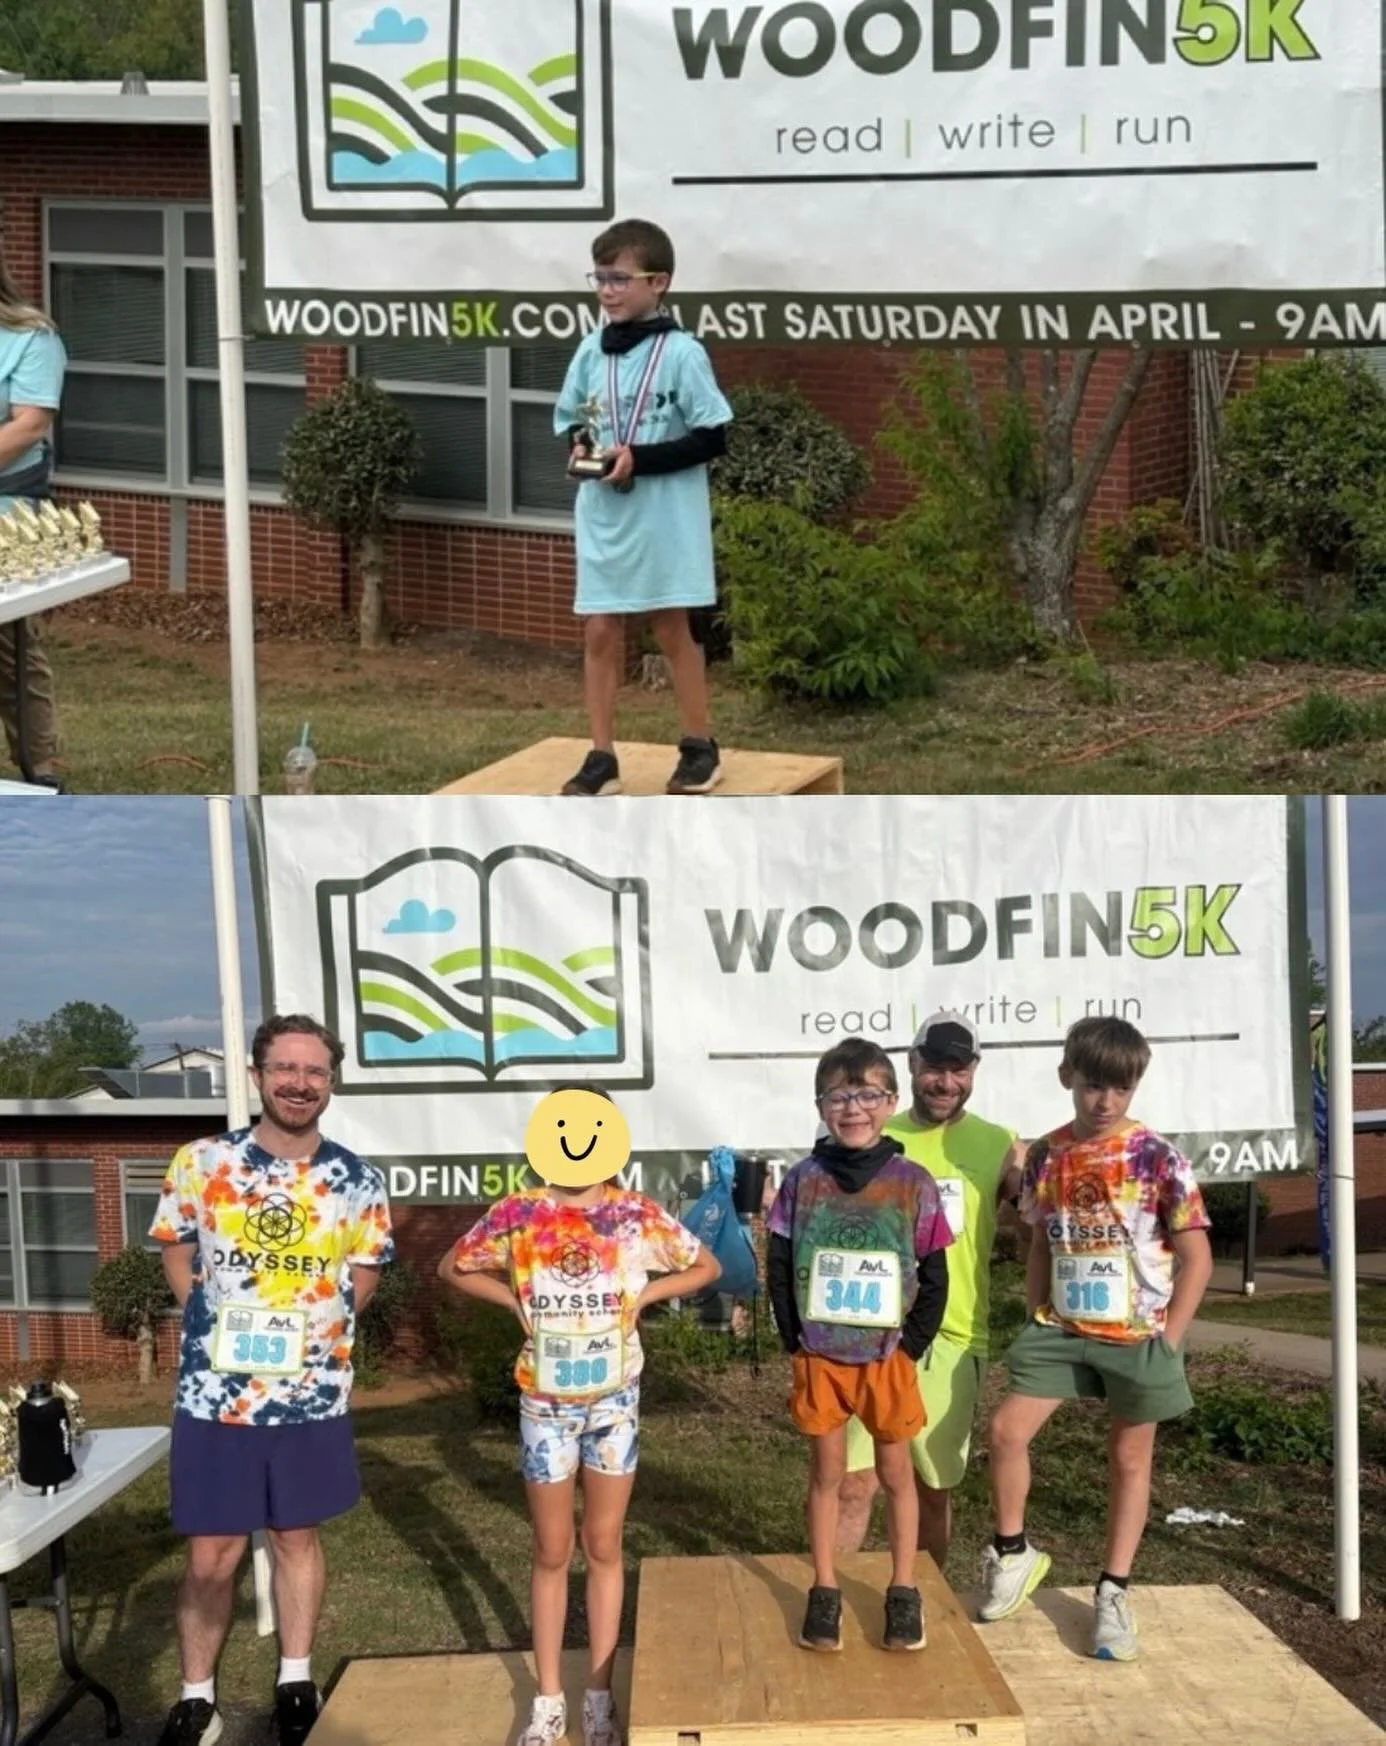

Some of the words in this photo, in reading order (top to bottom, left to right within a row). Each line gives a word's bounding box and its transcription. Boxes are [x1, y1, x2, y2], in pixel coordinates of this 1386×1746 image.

[673, 0, 1320, 79] WOODFIN5K
[776, 117, 882, 154] read
[938, 113, 1056, 150] write
[1116, 111, 1192, 146] run
[264, 299, 612, 338] WOODFIN5K.COM
[784, 302, 1002, 340] SATURDAY
[1020, 303, 1070, 340] IN
[1087, 302, 1221, 340] APRIL
[1276, 301, 1386, 340] 9AM
[703, 883, 1242, 974] WOODFIN5K
[800, 1003, 893, 1034] read
[1209, 1139, 1299, 1175] 9AM
[825, 1279, 882, 1314] 344
[1066, 1281, 1110, 1311] 316
[233, 1333, 287, 1364] 353
